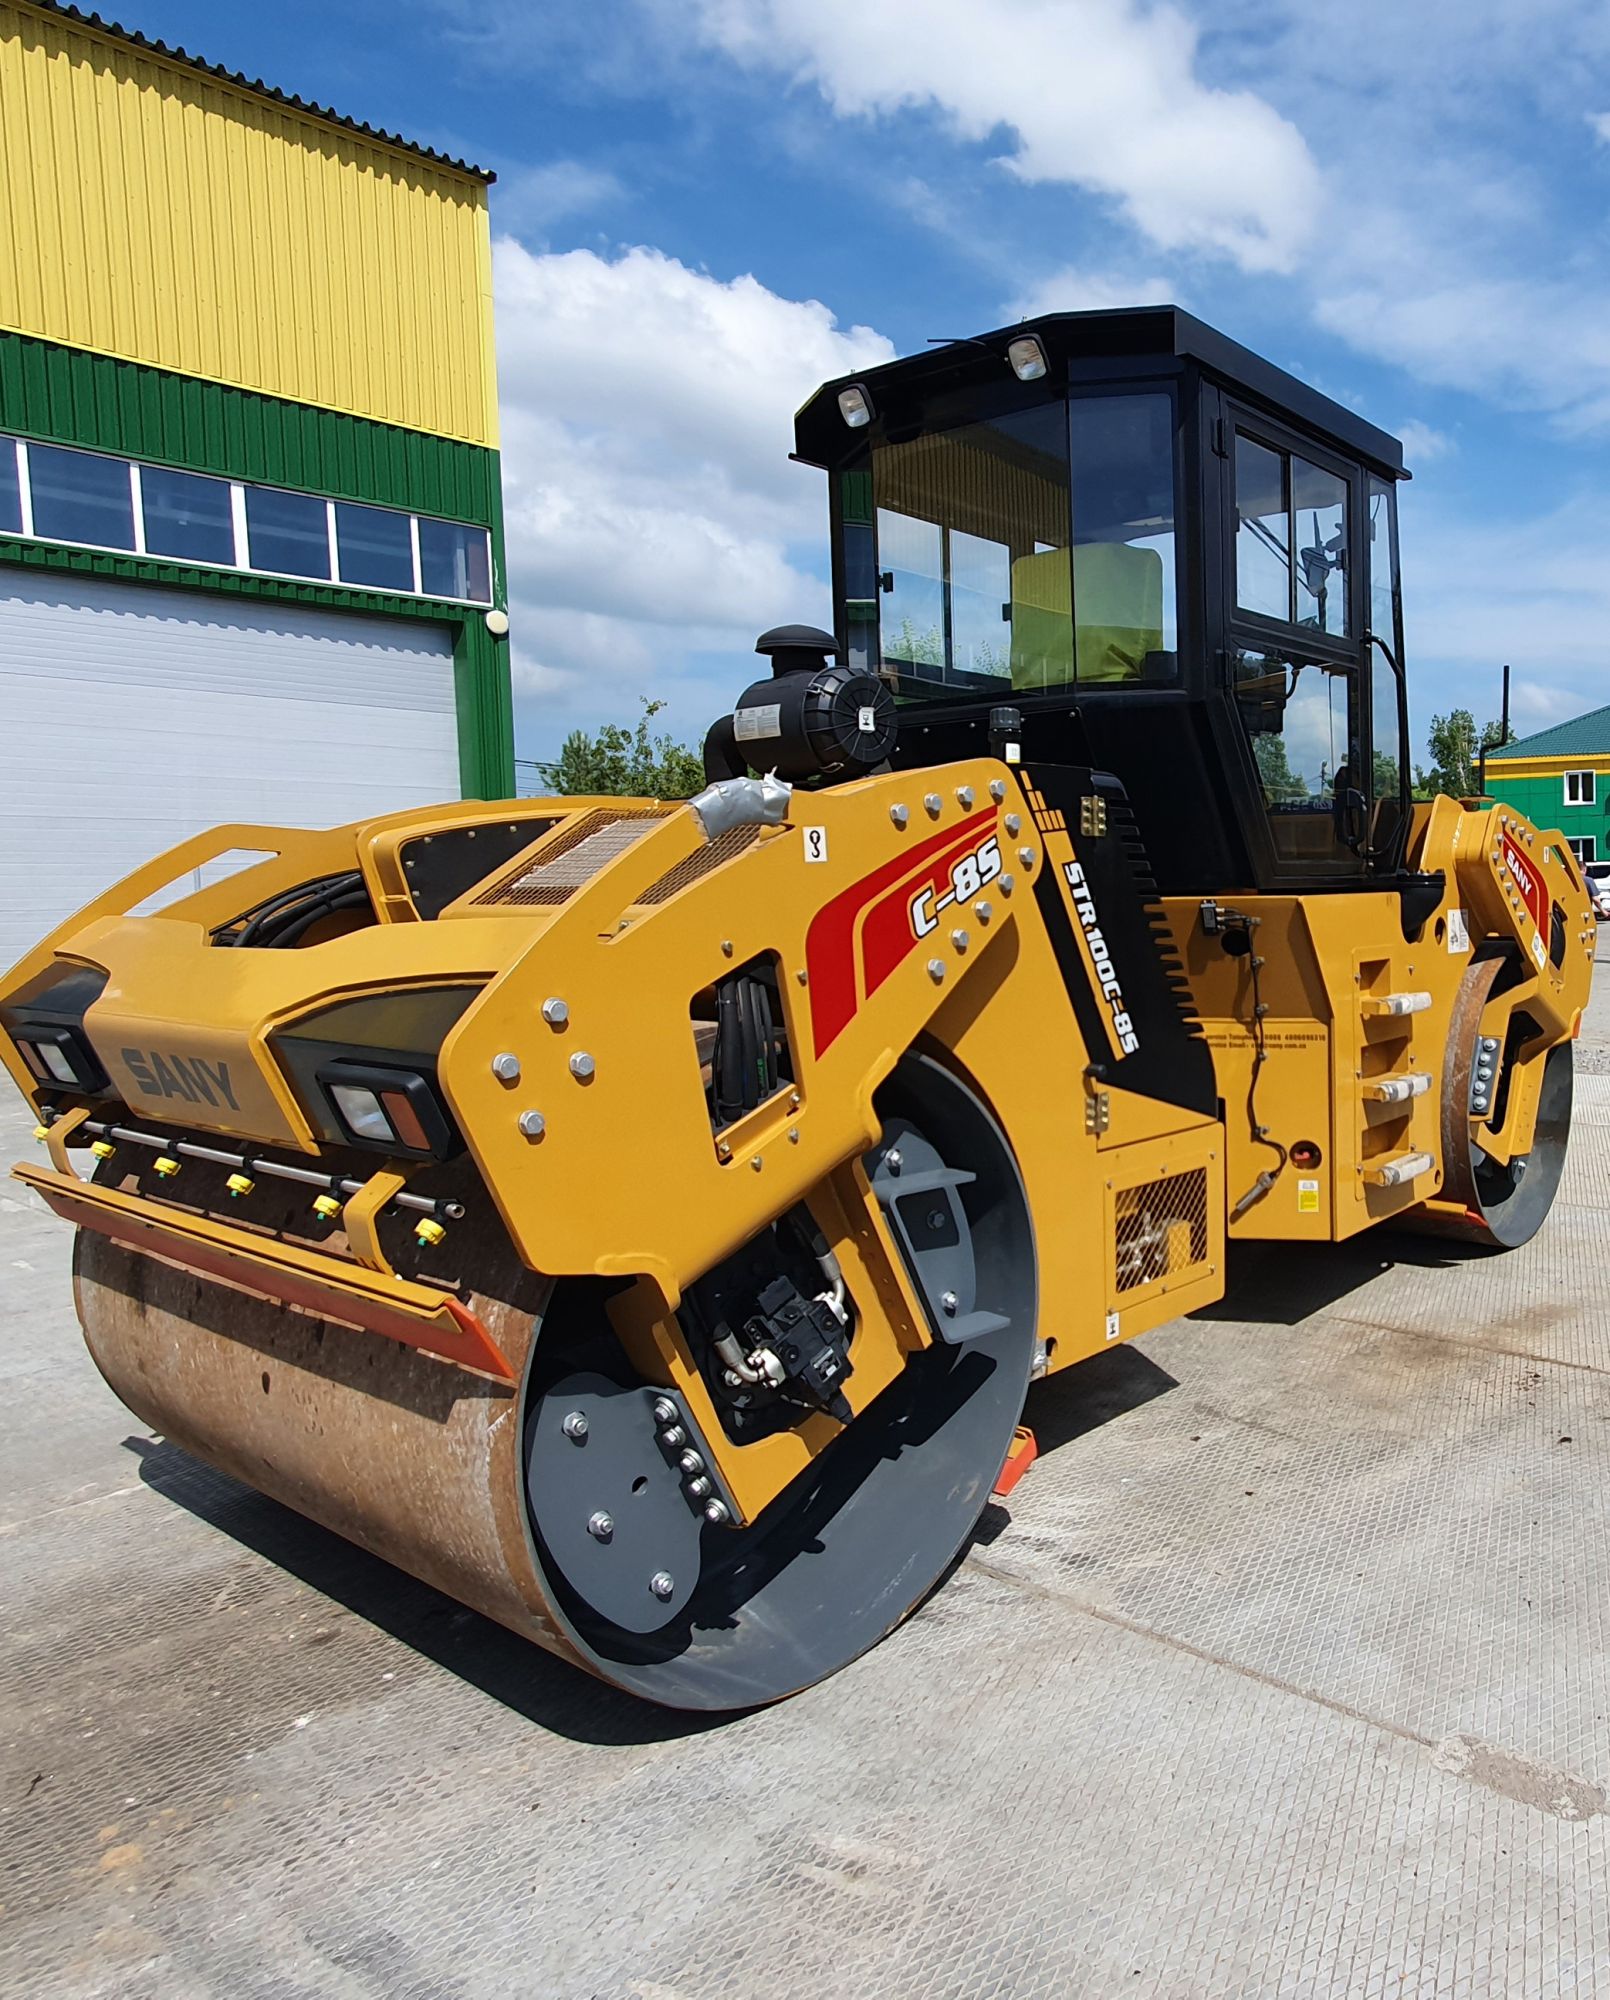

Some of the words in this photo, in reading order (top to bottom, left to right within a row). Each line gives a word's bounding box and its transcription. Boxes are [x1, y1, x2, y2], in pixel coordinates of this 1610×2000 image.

[910, 836, 1001, 938] C-85
[1506, 849, 1533, 896] SANY
[1063, 861, 1140, 1055] STR100C-85
[121, 1048, 241, 1112] SANY
